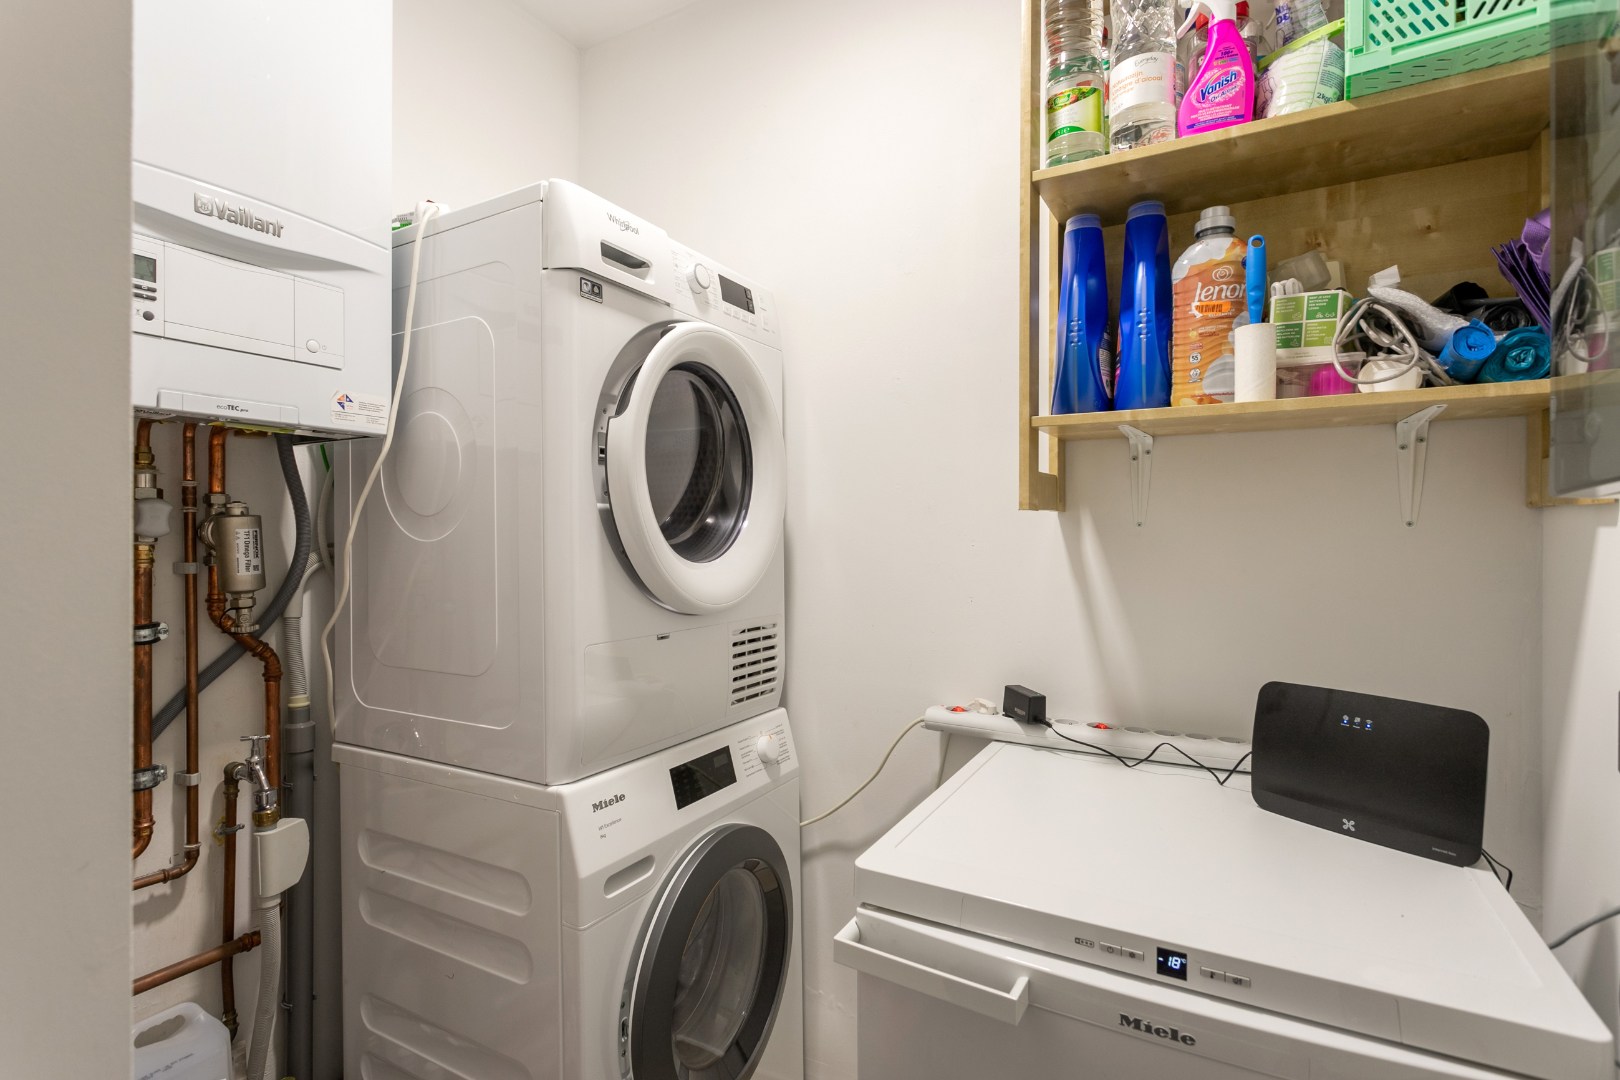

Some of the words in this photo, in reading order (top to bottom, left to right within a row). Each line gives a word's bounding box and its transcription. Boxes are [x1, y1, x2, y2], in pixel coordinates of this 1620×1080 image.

[1200, 70, 1237, 101] Vanish
[214, 197, 284, 239] Vaillant
[606, 212, 640, 235] Whirlpool
[216, 404, 240, 412] ecoTEC
[592, 793, 626, 813] Miele
[1118, 1012, 1197, 1047] Miele
